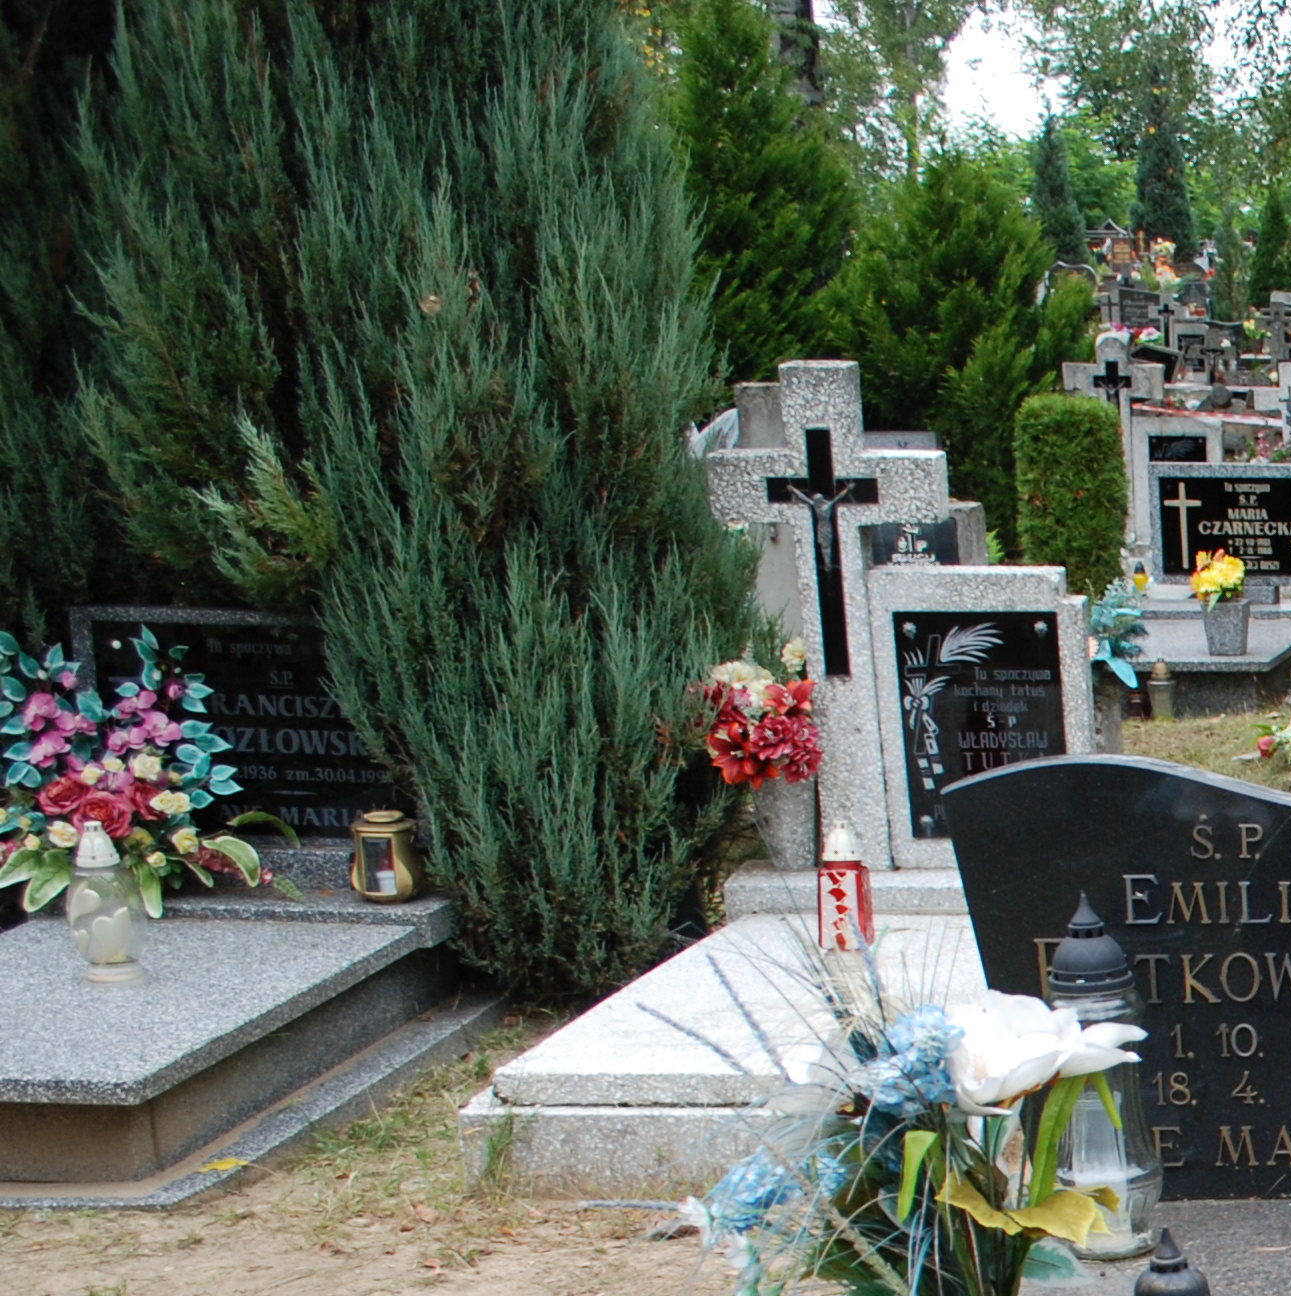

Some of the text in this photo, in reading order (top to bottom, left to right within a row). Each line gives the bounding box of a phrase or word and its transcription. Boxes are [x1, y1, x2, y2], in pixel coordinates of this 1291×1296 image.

[1228, 508, 1268, 521] MARIA
[974, 667, 1051, 683] Tu spoczywa
[954, 684, 1046, 698] kochany tatuś
[210, 693, 348, 718] RANCISZ
[982, 700, 1028, 714] dziadek
[214, 727, 369, 756] OZŁOWSK
[958, 731, 1049, 749] WŁADYSŁAW
[218, 804, 263, 822] AV
[1170, 1023, 1195, 1059] 1.
[1215, 1022, 1265, 1059] 10.
[1152, 1071, 1197, 1107] 18.
[1231, 1070, 1266, 1105] 4.
